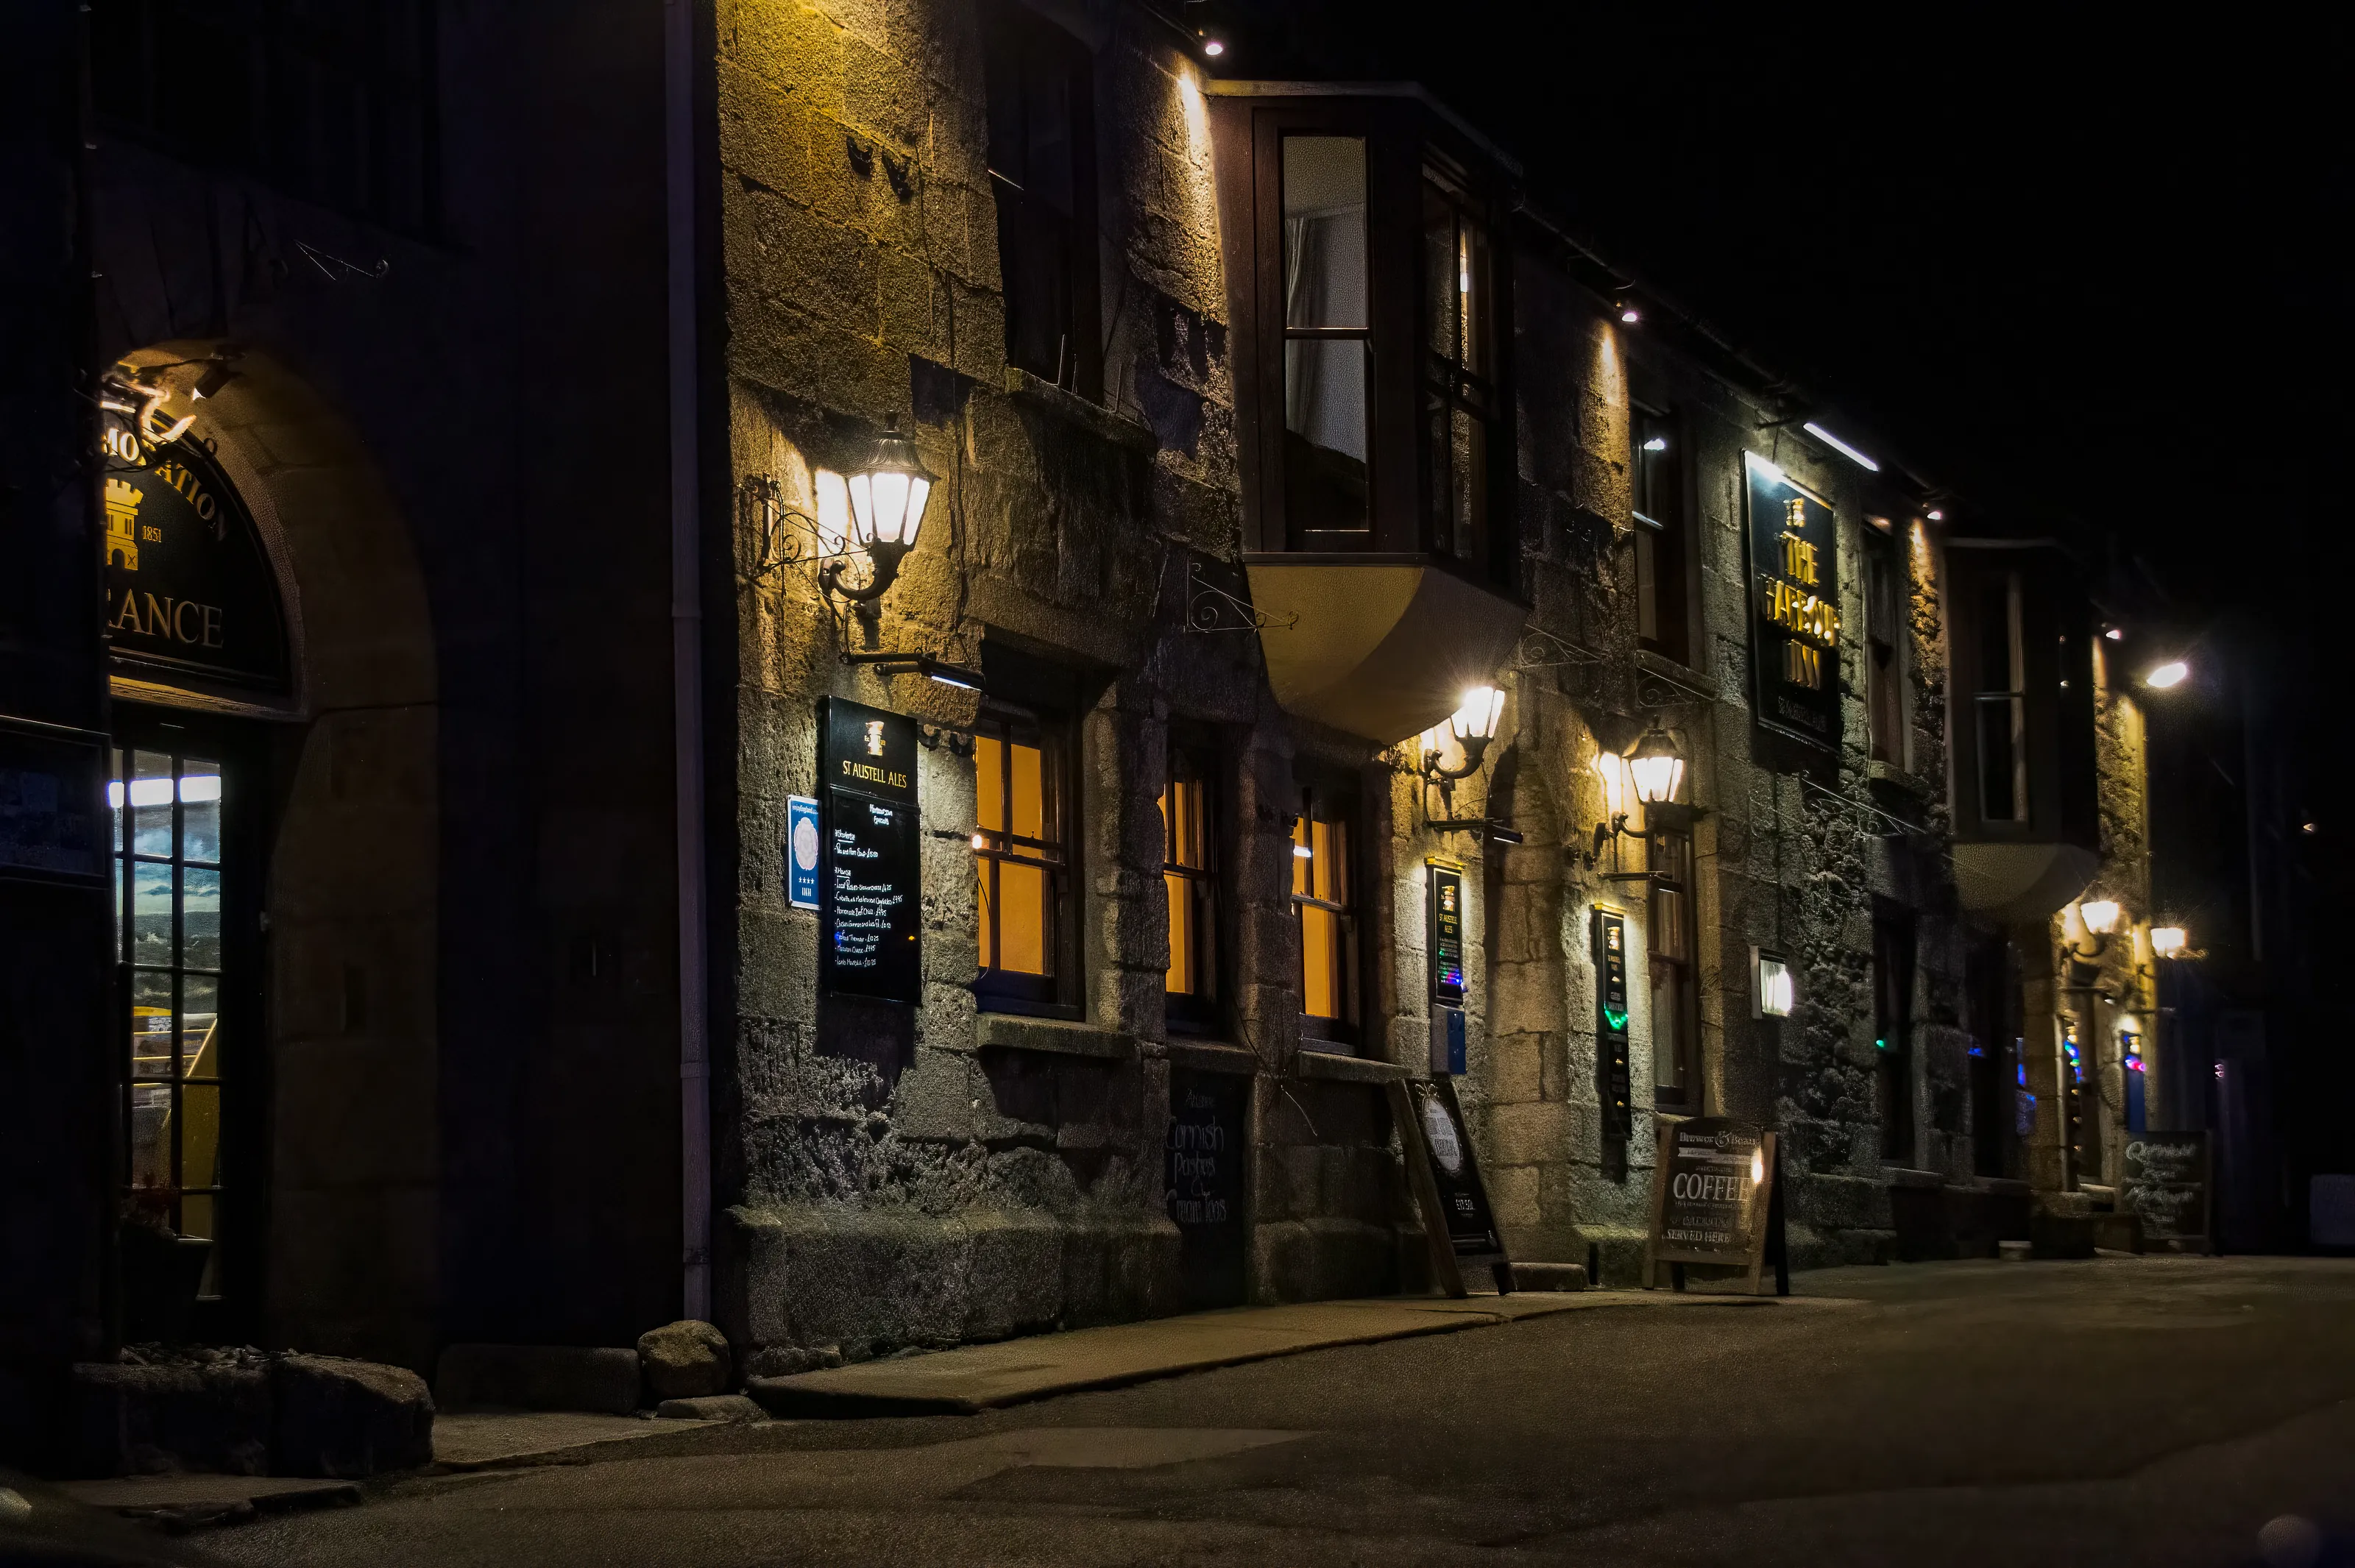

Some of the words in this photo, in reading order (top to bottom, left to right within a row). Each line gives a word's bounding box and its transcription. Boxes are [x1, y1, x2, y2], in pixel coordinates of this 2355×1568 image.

[142, 525, 162, 543] 1851
[1777, 530, 1820, 586] THE
[1782, 639, 1821, 690] INN
[843, 760, 851, 776] ST
[852, 763, 886, 784] AUSTELL
[888, 771, 907, 788] ALES
[1673, 1172, 1752, 1202] COFFEE
[1667, 1229, 1704, 1242] SERVED
